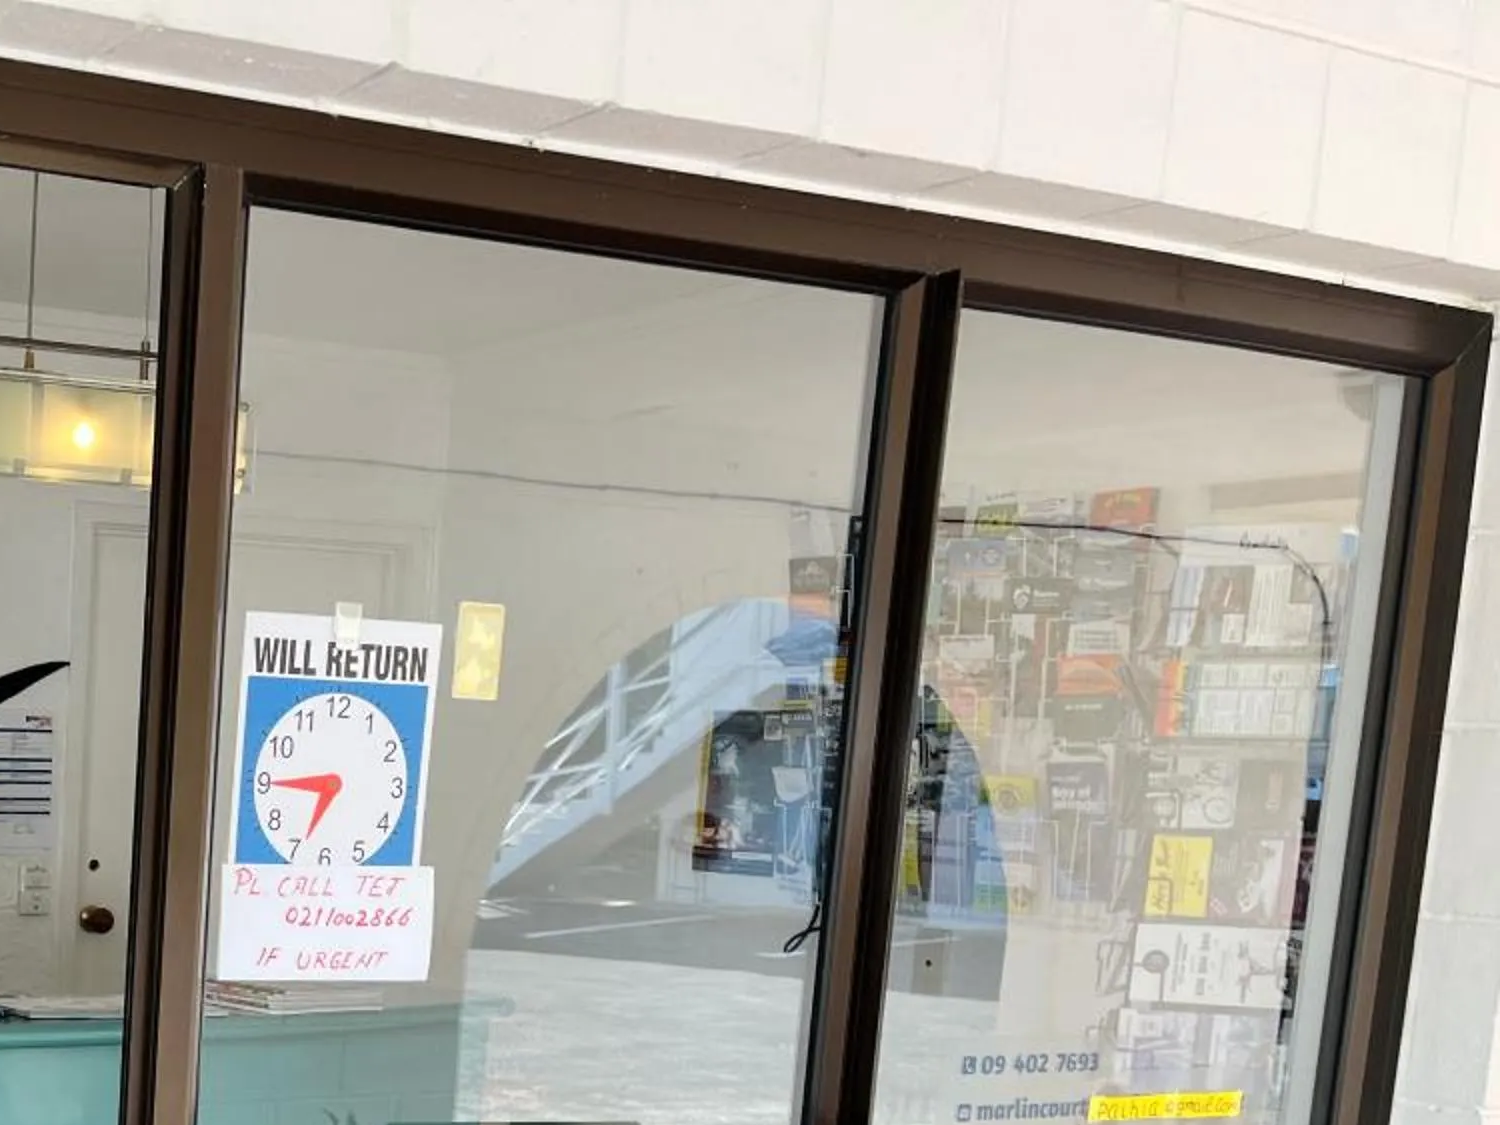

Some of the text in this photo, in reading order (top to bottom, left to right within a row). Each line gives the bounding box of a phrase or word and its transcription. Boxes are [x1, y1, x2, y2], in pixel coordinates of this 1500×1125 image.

[254, 637, 428, 682] WILL RETURN
[326, 695, 351, 719] 12
[295, 710, 315, 733] 11
[365, 713, 375, 734] 1
[269, 736, 295, 759] 10
[383, 740, 398, 763] 2
[257, 772, 272, 795] 9
[390, 777, 404, 799] 3
[267, 809, 282, 831] 8
[376, 812, 390, 834] 4
[288, 838, 301, 860] 7
[318, 846, 331, 865] 6
[352, 840, 366, 863] 5
[234, 867, 261, 896] PL
[276, 875, 335, 897] CALL
[256, 946, 389, 971] IF URGENT
[980, 1051, 1100, 1075] 09 402 7693
